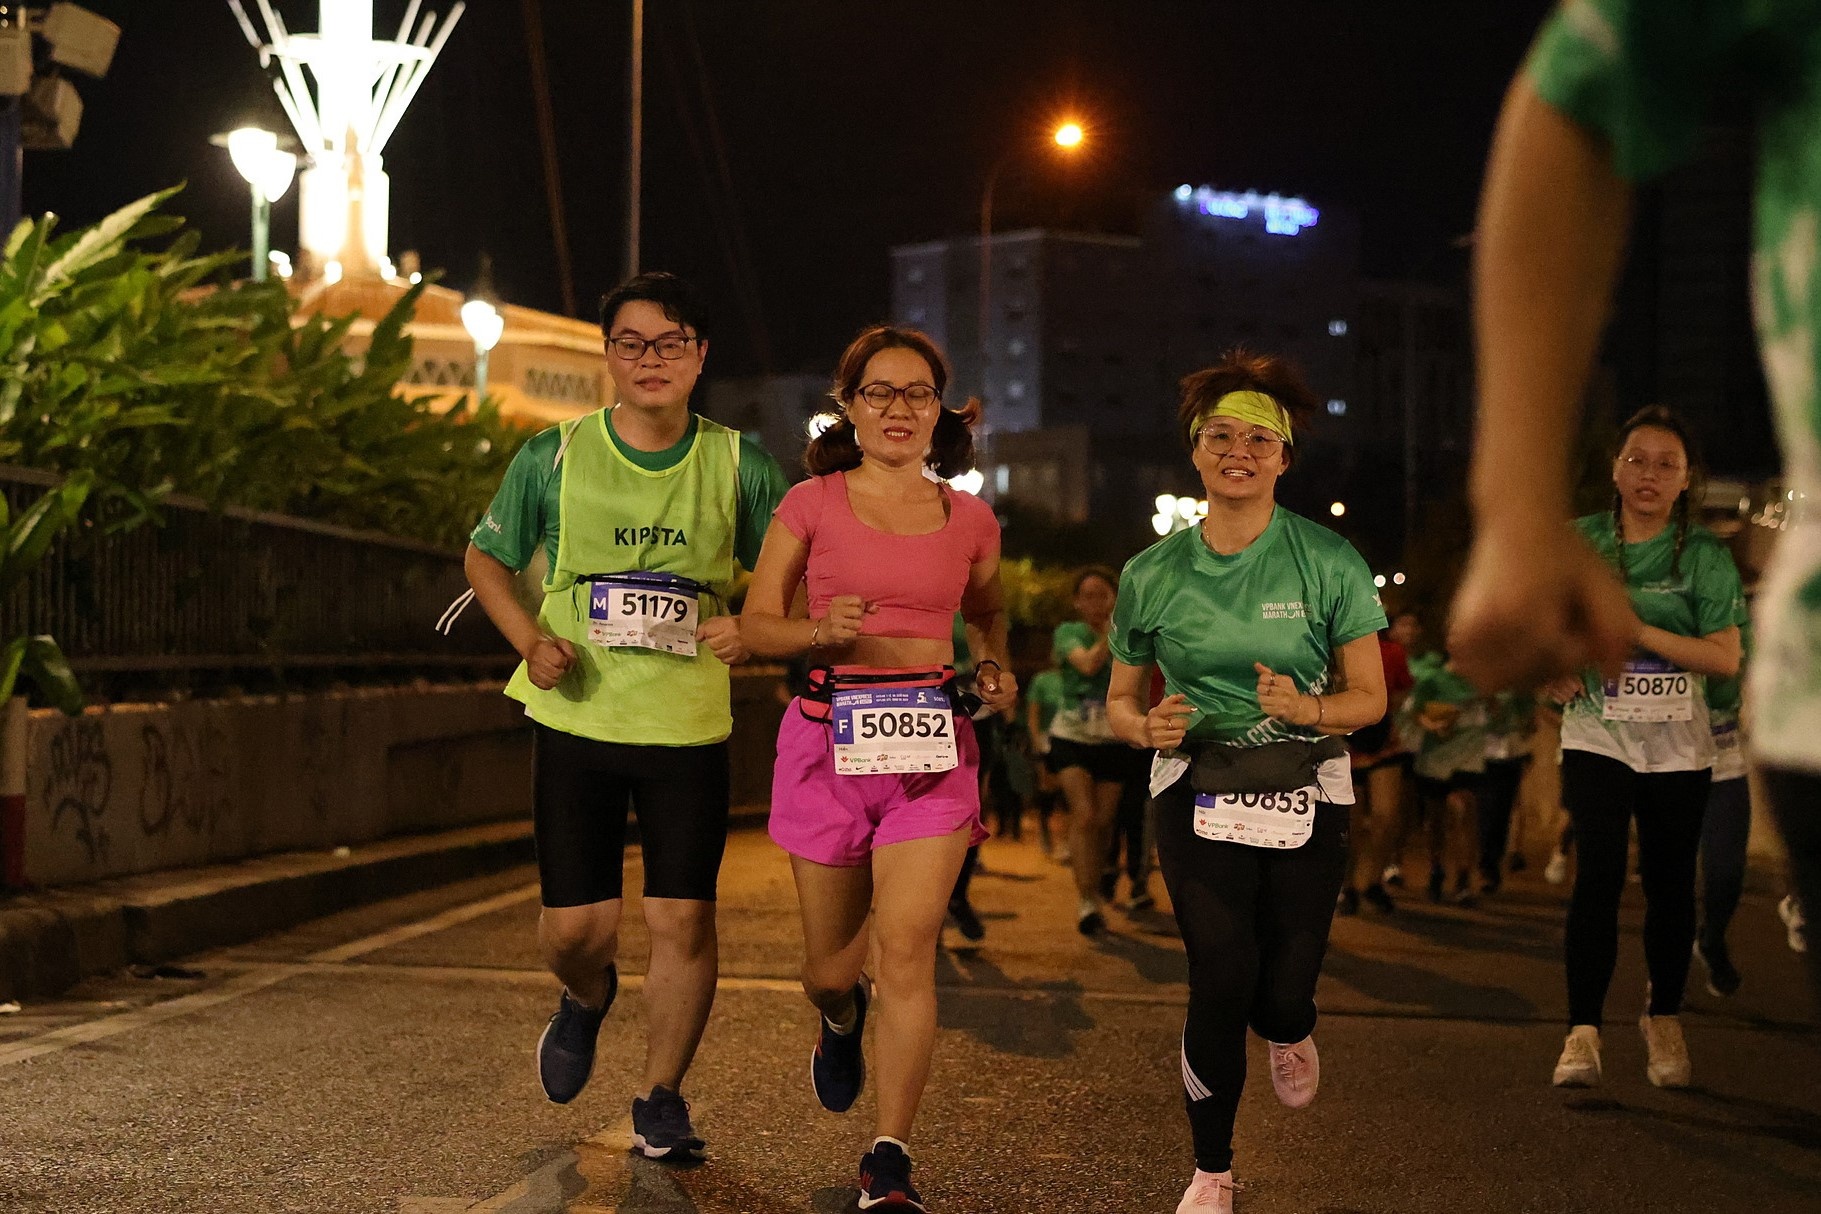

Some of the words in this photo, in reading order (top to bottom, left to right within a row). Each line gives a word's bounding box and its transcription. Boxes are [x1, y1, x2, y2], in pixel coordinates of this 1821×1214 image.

[614, 527, 687, 546] KIPSTA
[593, 597, 607, 611] M
[621, 592, 688, 623] 51179
[1262, 602, 1286, 611] VPBANK
[1624, 676, 1687, 696] 50870
[838, 719, 849, 734] F
[861, 712, 949, 739] 50852
